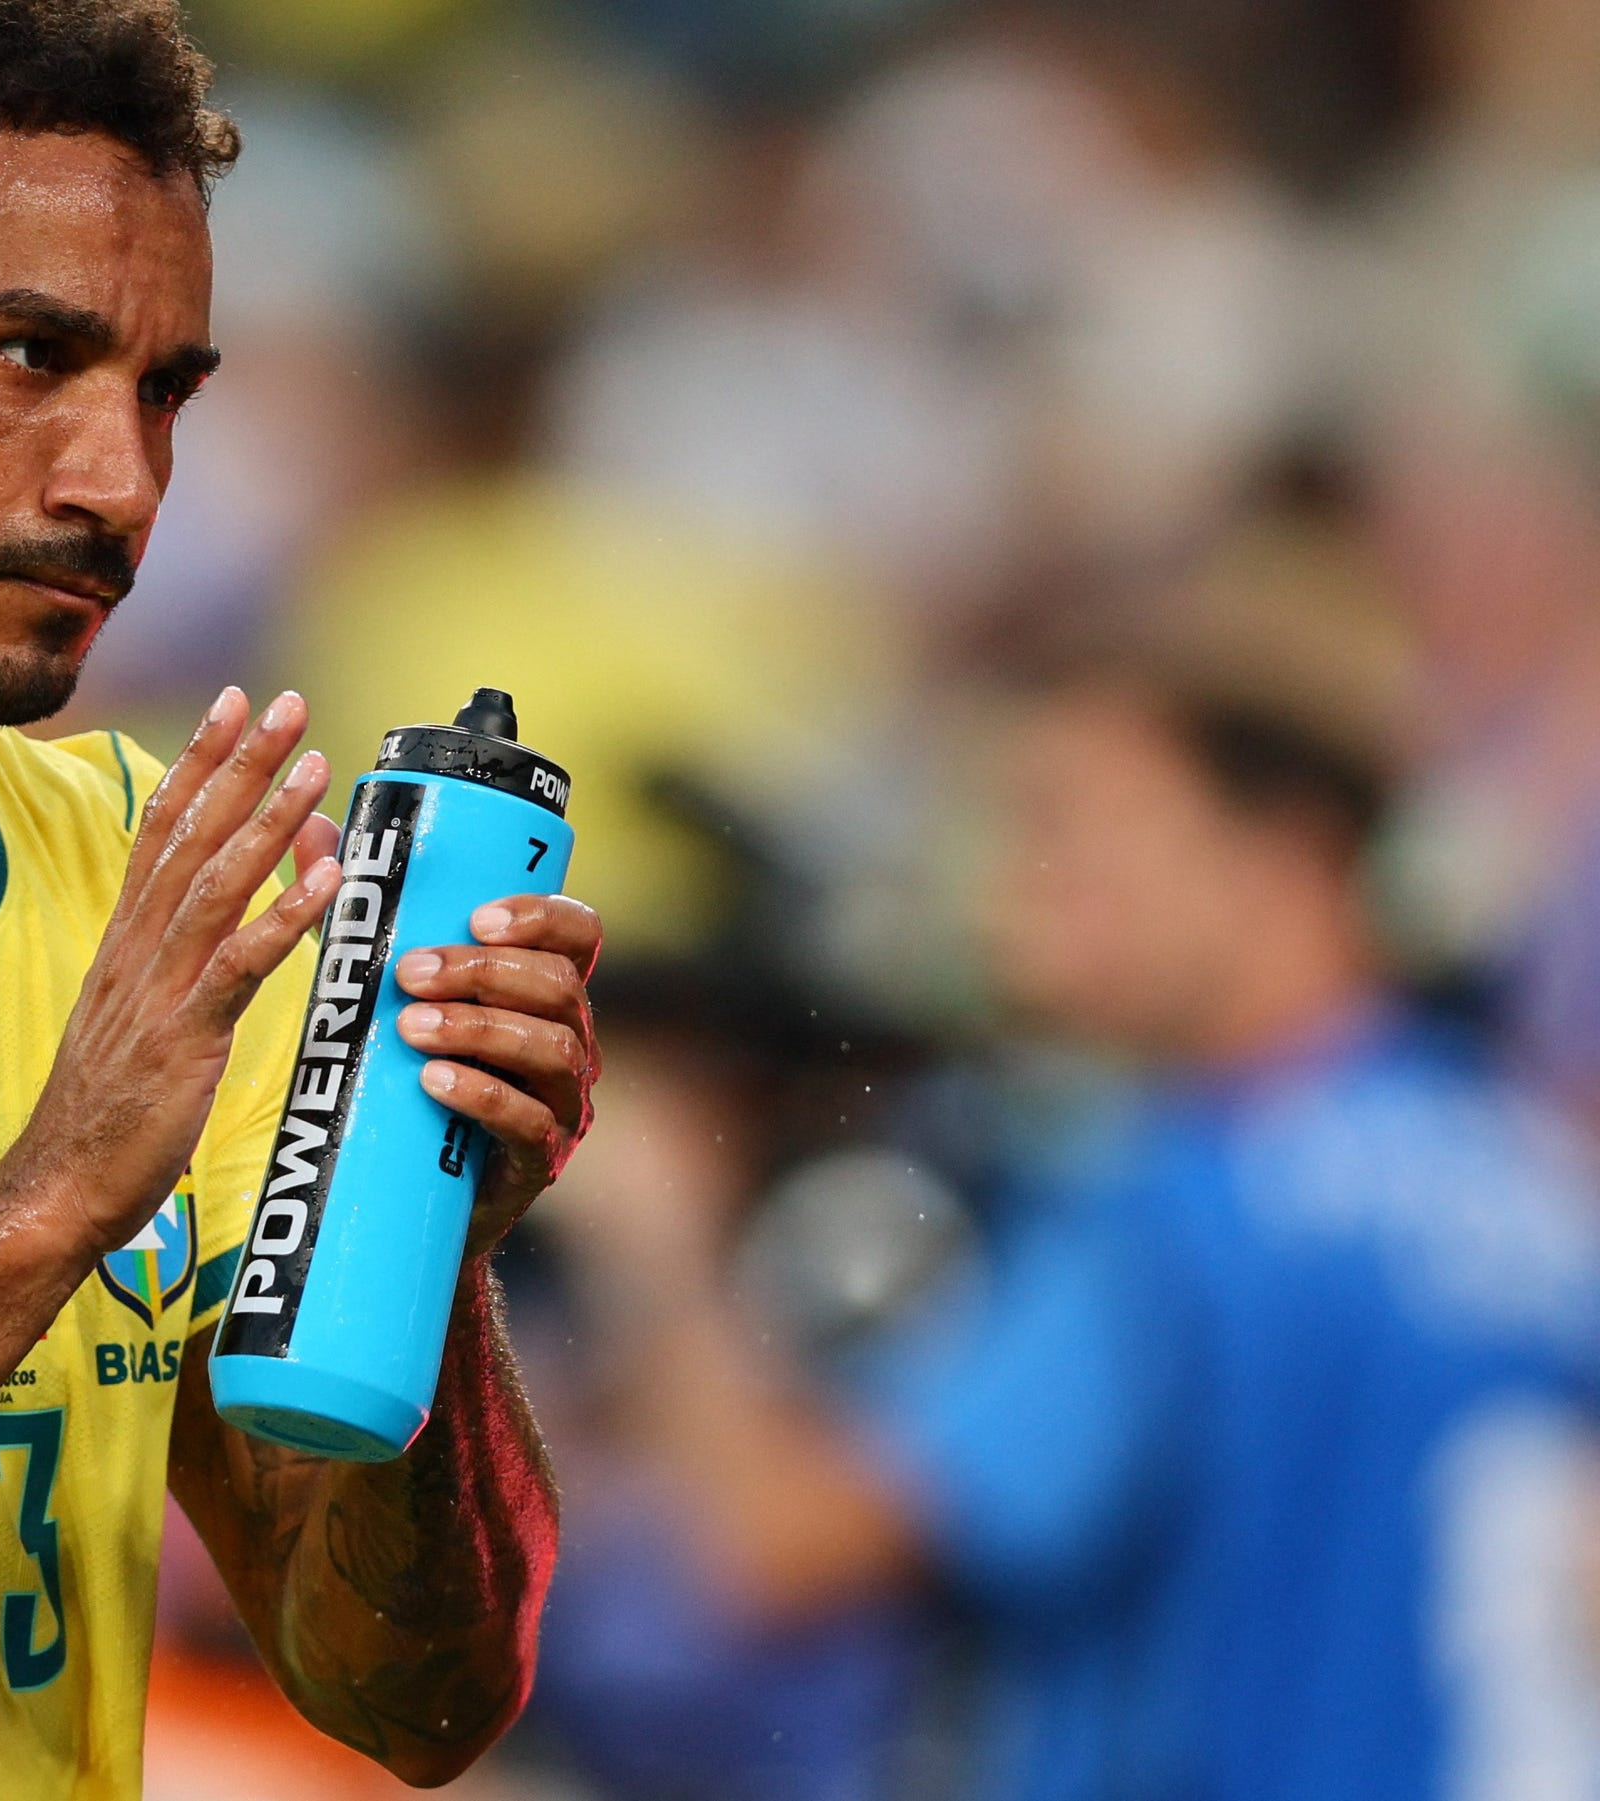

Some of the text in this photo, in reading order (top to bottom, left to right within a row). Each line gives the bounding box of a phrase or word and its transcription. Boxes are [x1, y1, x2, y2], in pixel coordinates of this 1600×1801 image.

[525, 837, 549, 873] 7
[231, 828, 399, 1316] POWERADE
[95, 1340, 181, 1386] BAS
